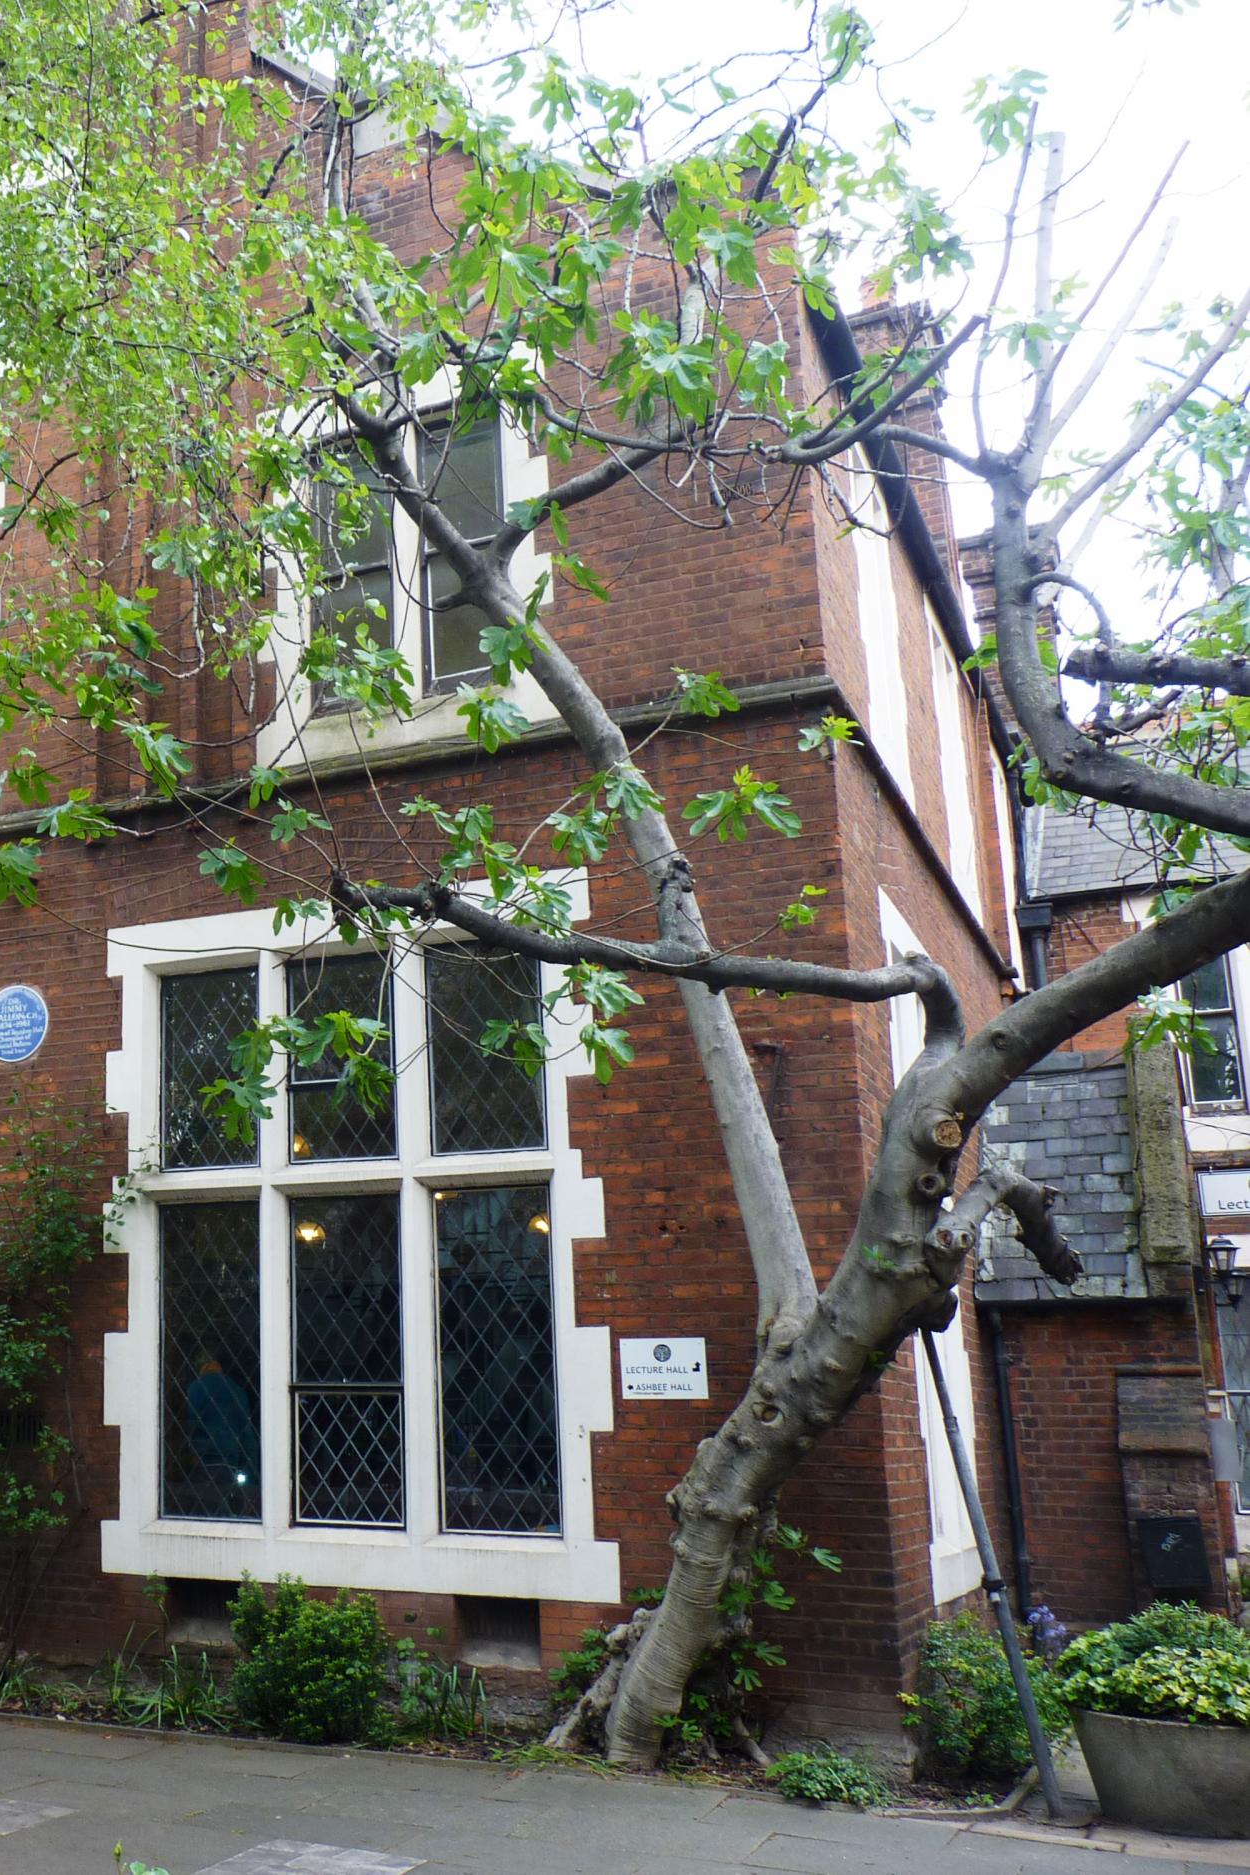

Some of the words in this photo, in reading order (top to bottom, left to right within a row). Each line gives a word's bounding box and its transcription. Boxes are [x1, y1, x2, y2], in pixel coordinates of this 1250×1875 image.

[1, 1004, 27, 1013] JIMMY
[626, 1366, 663, 1374] LECTURE
[666, 1366, 689, 1374] HALL
[636, 1383, 667, 1391] ASHBEE
[670, 1383, 694, 1391] HALL
